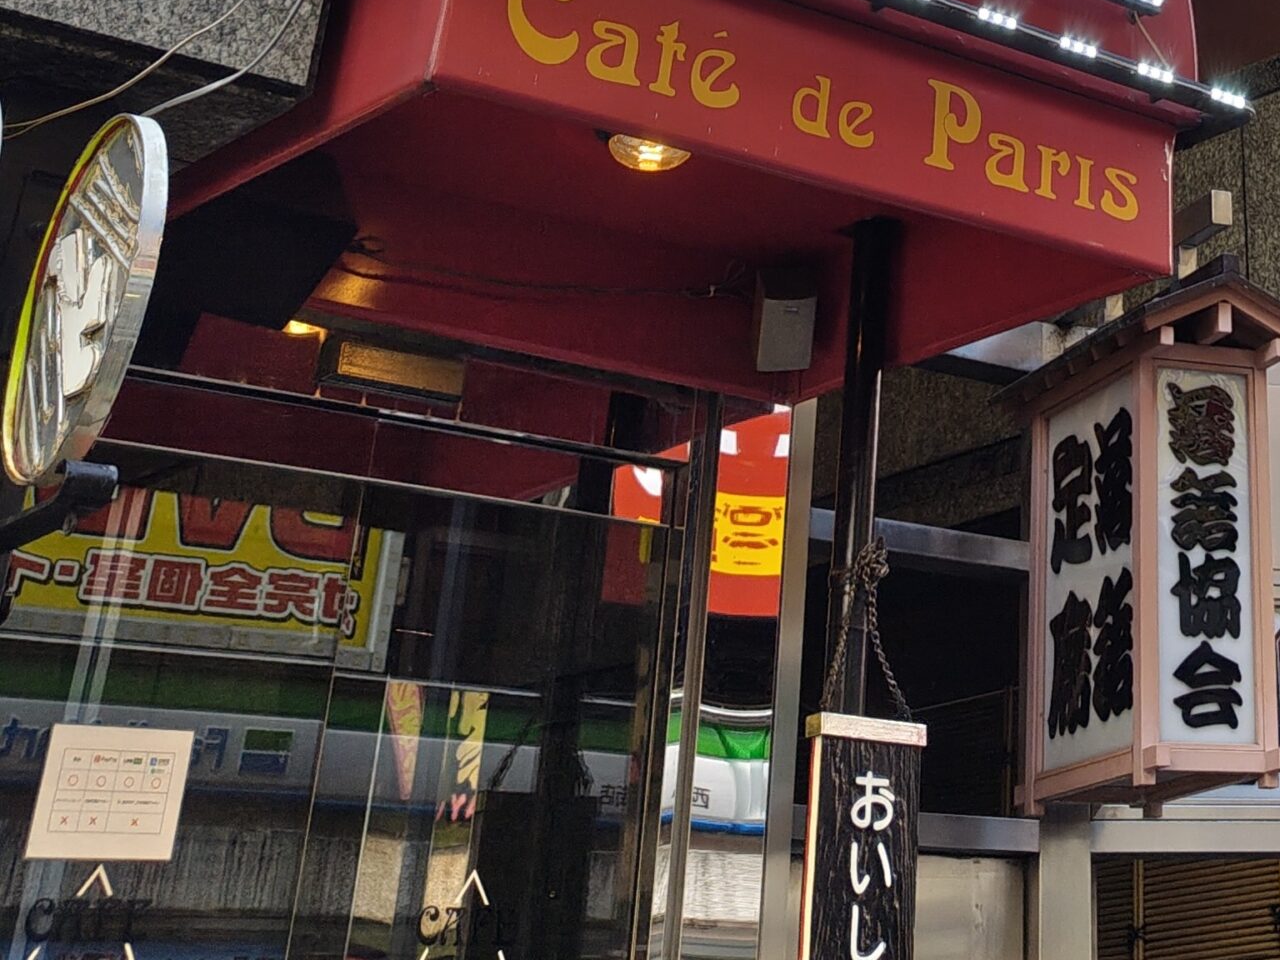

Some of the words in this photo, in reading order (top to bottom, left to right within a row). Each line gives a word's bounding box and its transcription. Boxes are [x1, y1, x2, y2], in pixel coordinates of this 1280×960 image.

[792, 76, 875, 149] de
[923, 78, 1139, 221] Paris
[1167, 382, 1243, 730] 落語協会
[850, 770, 895, 960] おいし
